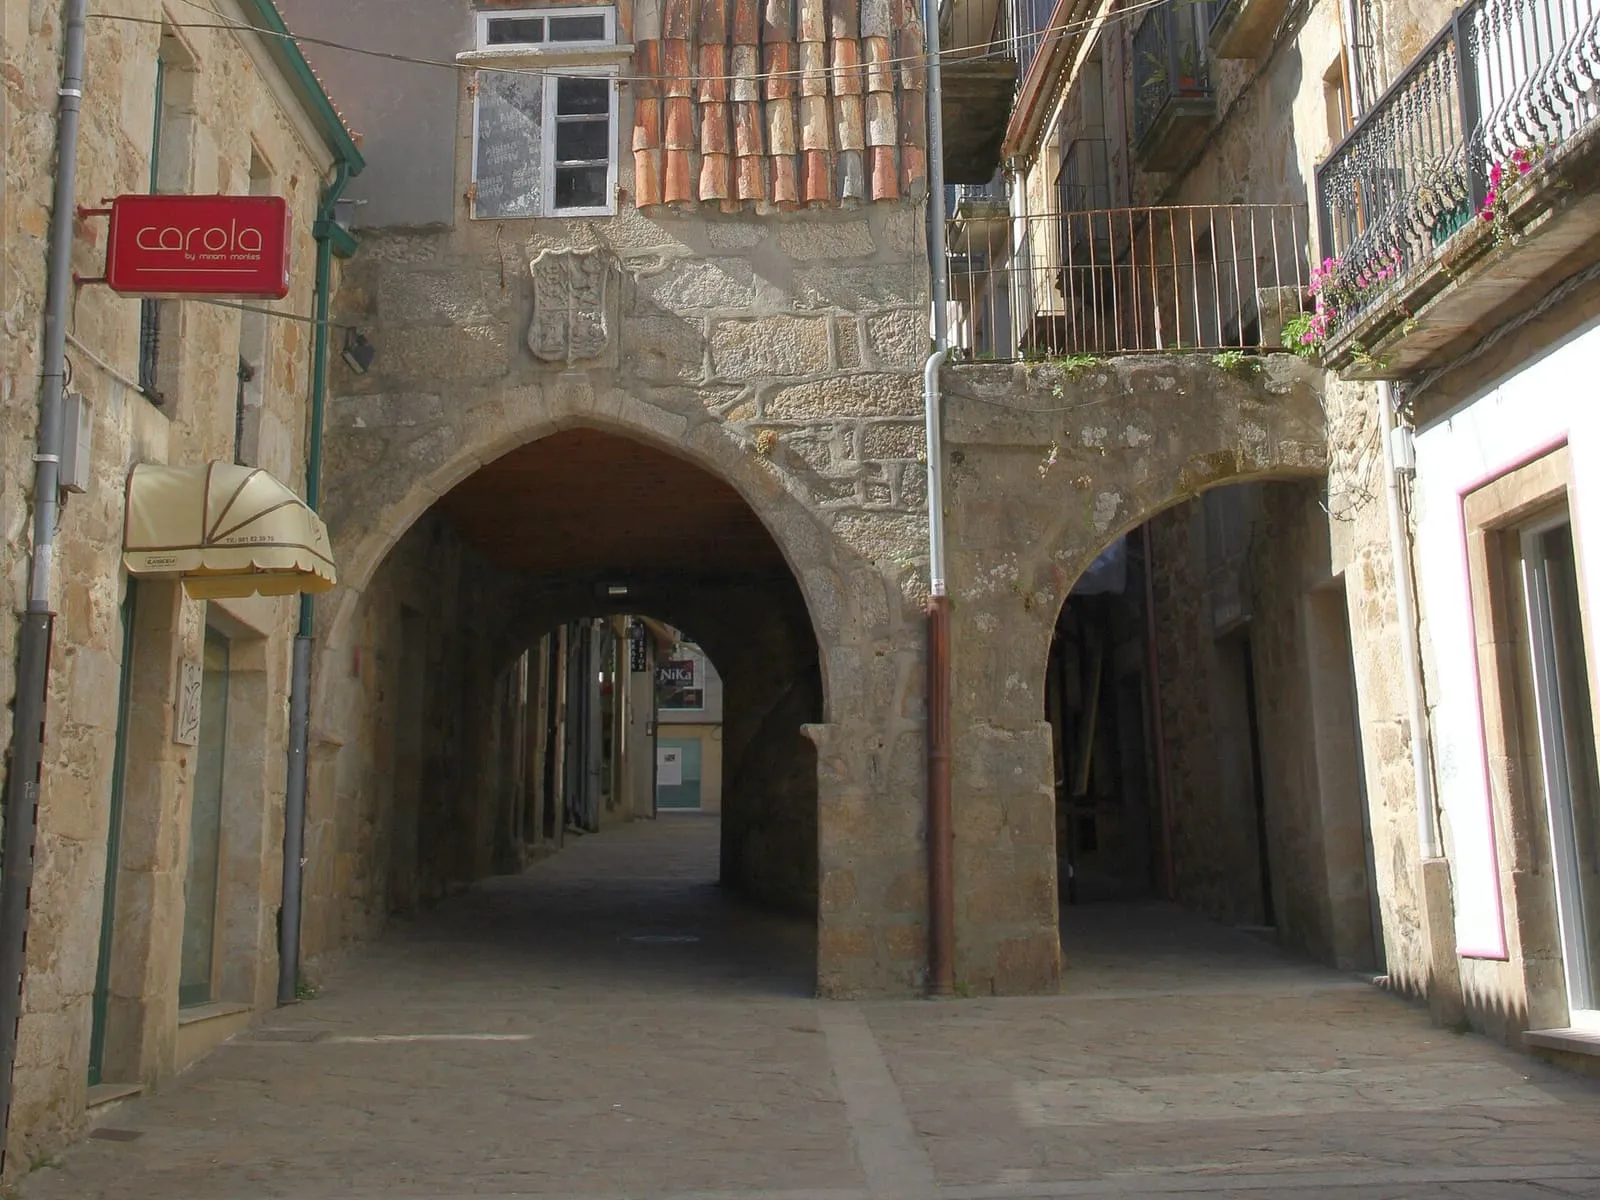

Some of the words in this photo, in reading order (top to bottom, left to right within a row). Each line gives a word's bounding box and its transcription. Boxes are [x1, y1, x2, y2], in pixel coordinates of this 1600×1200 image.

[136, 218, 262, 251] carola
[184, 253, 196, 261] by
[660, 668, 692, 680] NiKa
